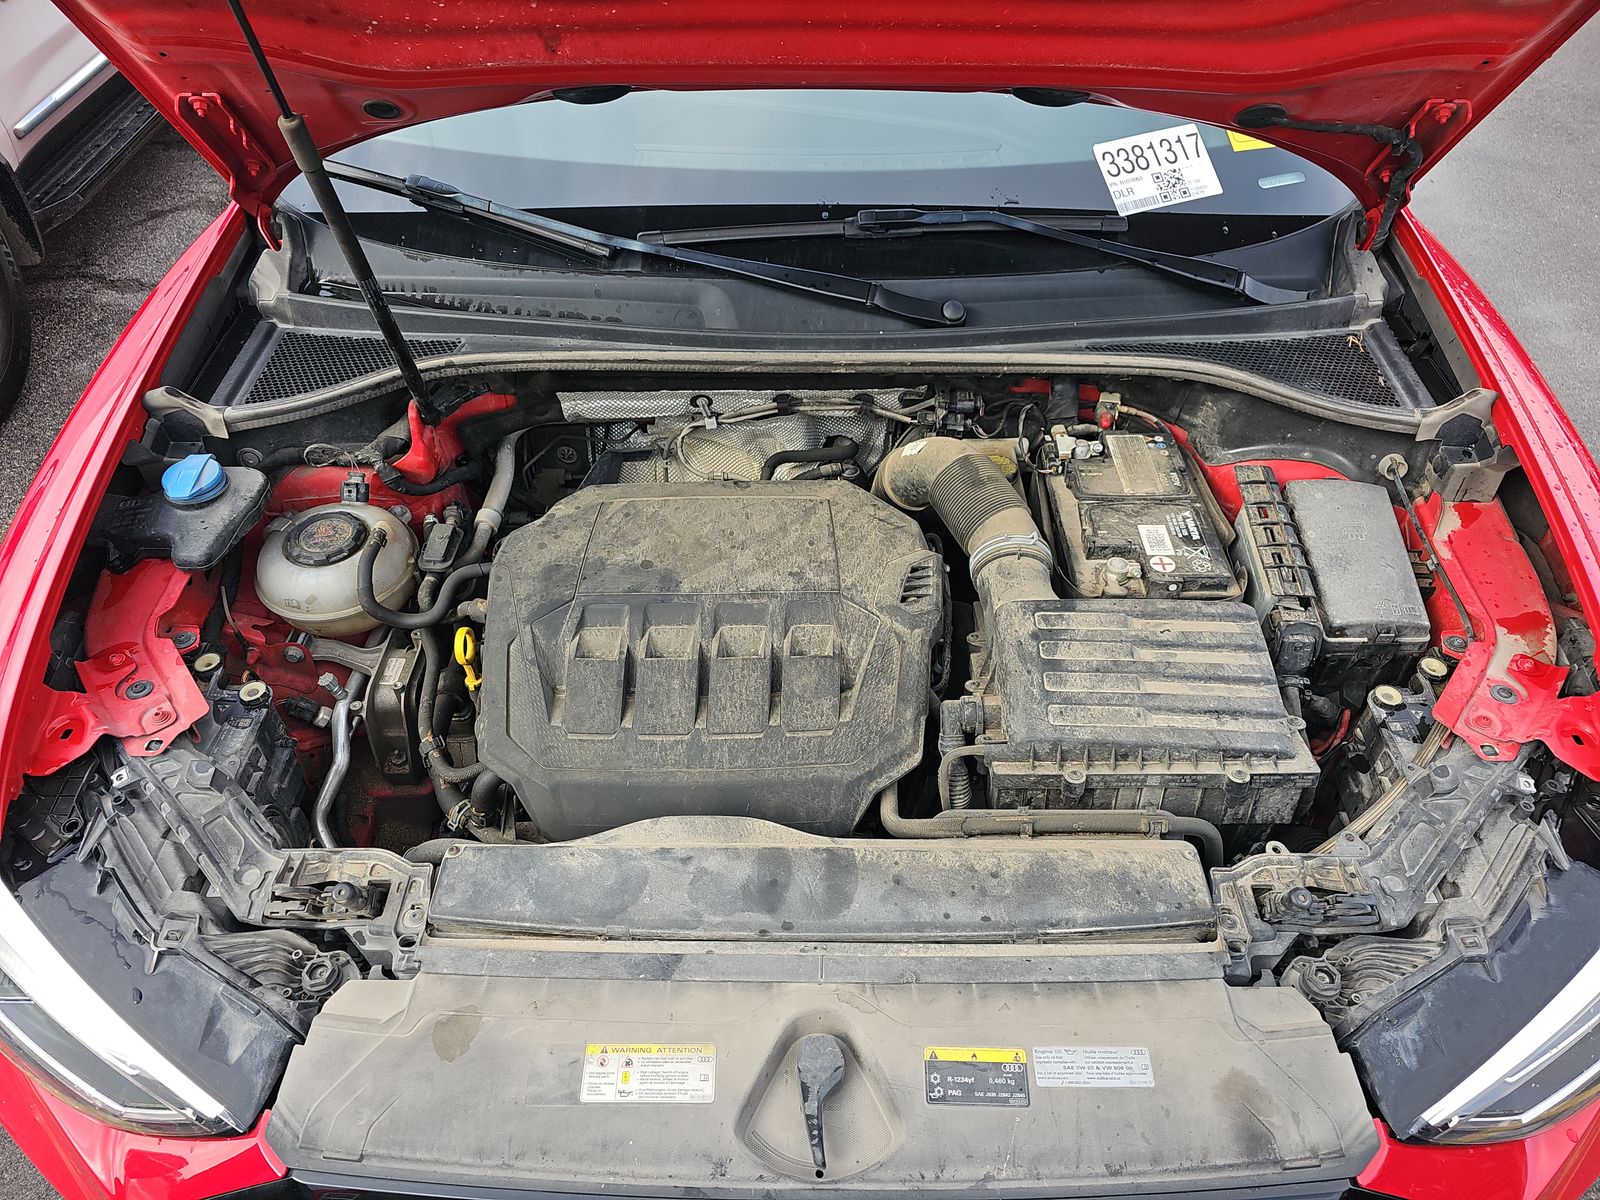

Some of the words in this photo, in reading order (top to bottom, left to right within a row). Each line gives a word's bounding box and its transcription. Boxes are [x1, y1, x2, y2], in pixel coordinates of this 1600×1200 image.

[1102, 132, 1201, 178] 3381317
[1112, 187, 1135, 200] DLR
[1185, 517, 1201, 541] VARTA
[947, 1076, 975, 1084] R-1234yf
[1008, 1078, 1016, 1086] kg
[948, 1089, 962, 1097] PAG
